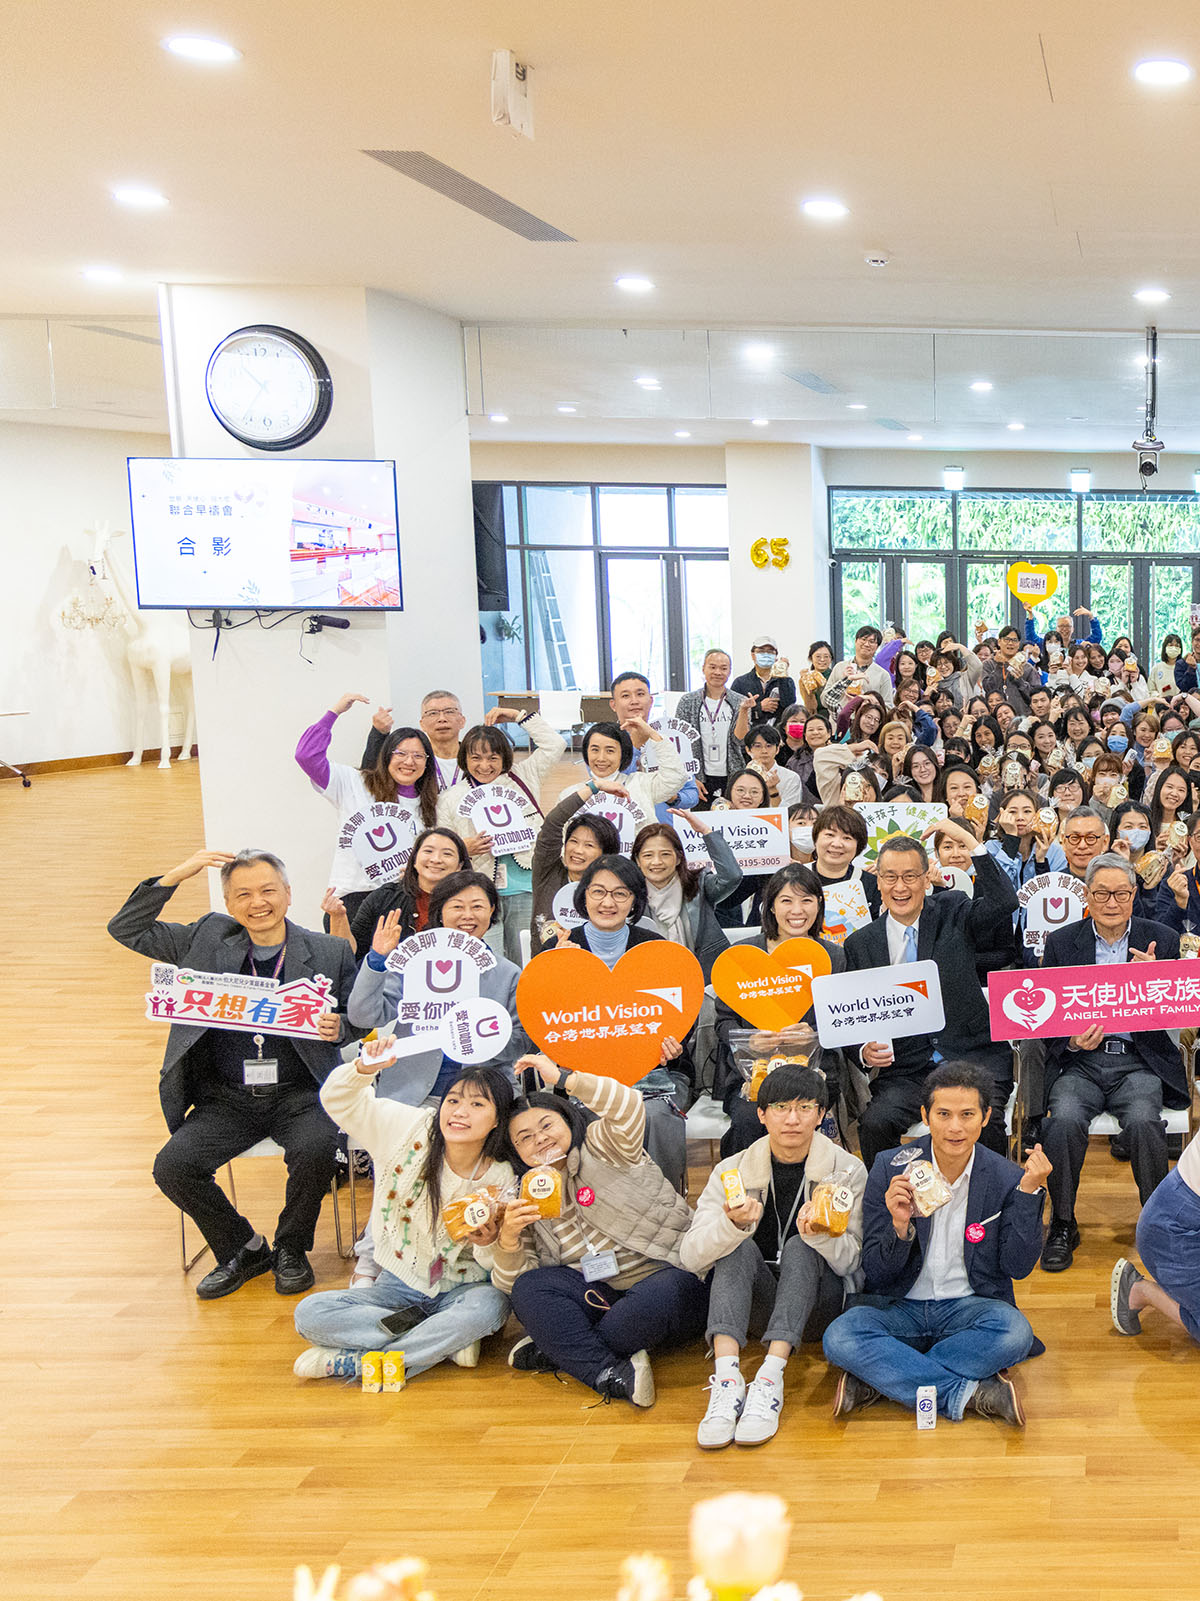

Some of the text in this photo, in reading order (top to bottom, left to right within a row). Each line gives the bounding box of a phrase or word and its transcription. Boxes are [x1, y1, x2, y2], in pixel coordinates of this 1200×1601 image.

[169, 504, 233, 516] 聯合早禱會
[177, 536, 232, 557] 合影
[750, 537, 790, 571] 65
[727, 824, 769, 837] Vision
[387, 931, 494, 971] 慢慢聊 慢慢療
[737, 974, 803, 990] World Vision
[177, 992, 325, 1029] 只想有家
[541, 1002, 663, 1026] World Vision
[828, 994, 915, 1015] World Vision
[1063, 1010, 1108, 1022] ANGEL
[1112, 1006, 1156, 1018] HEART
[455, 1009, 475, 1057] 愛你咖啡
